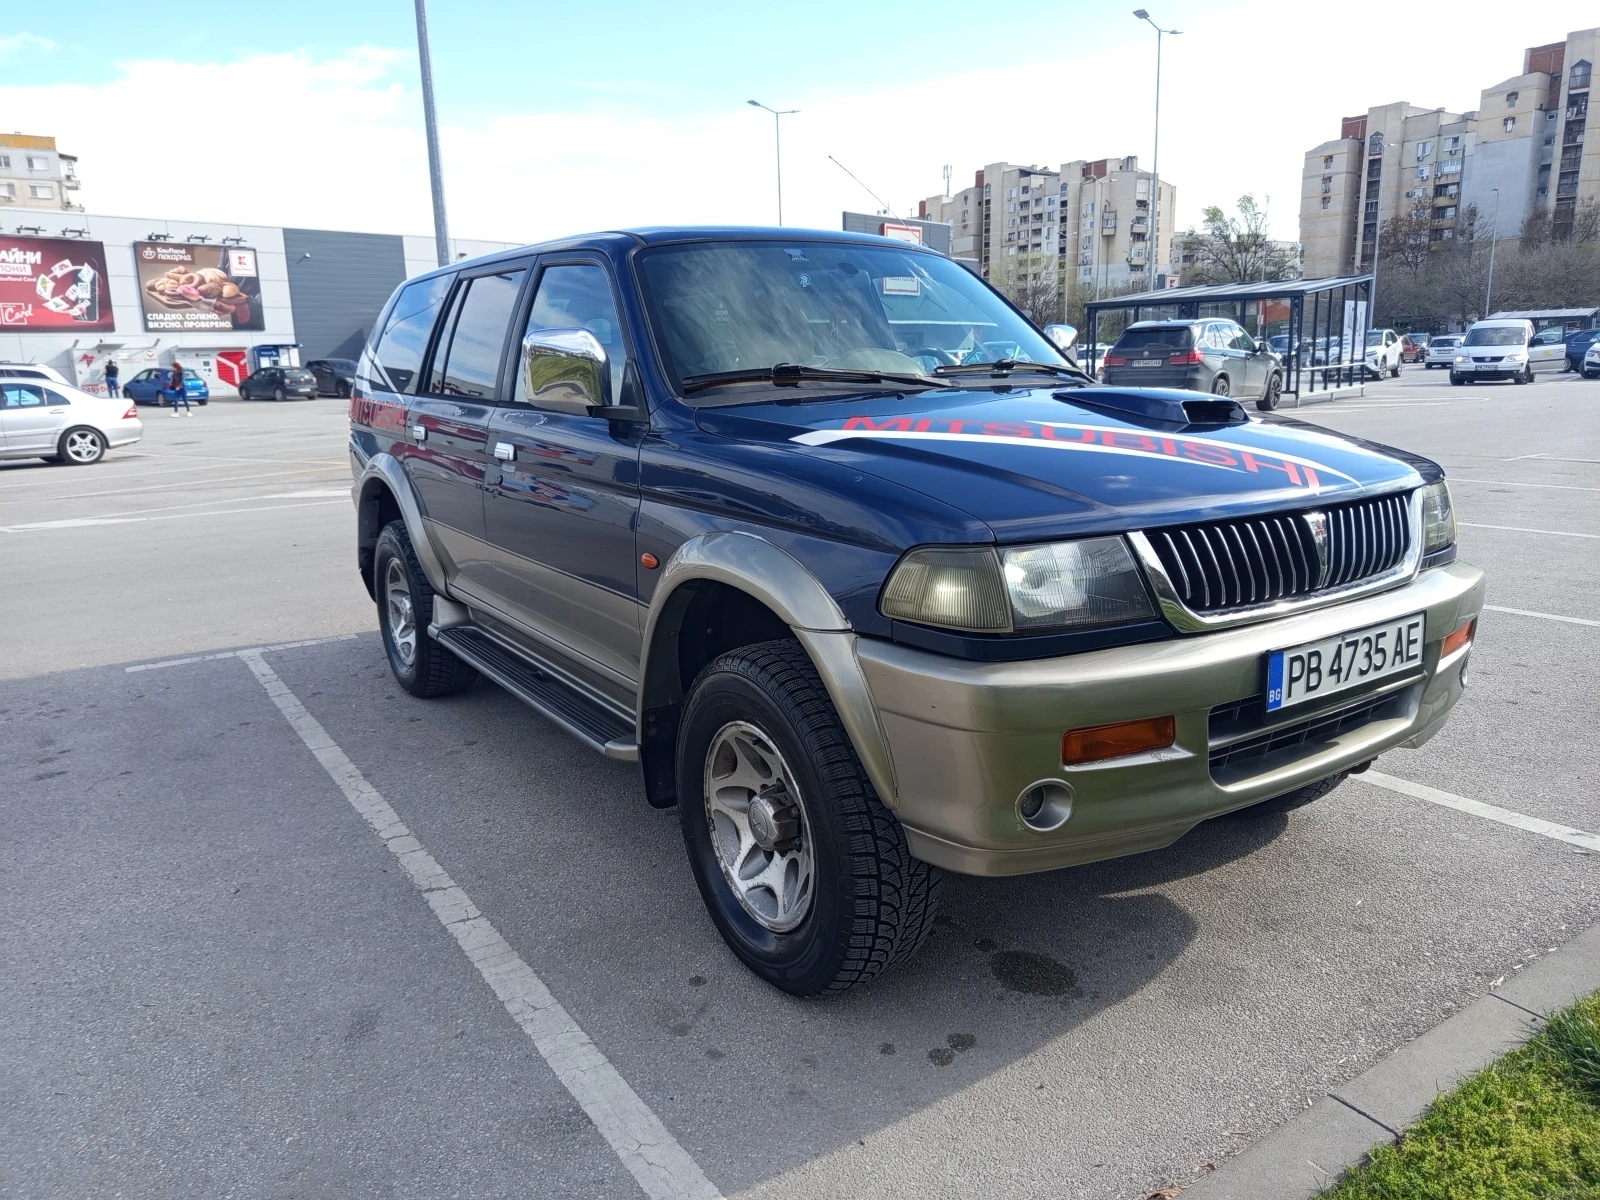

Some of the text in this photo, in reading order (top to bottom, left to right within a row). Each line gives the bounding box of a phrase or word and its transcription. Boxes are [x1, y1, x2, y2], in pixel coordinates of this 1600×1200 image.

[5, 303, 34, 322] Card
[148, 321, 233, 329] ВКУСНО. ПРОВЕРЕНО.
[842, 415, 1321, 497] MITSUBISHI
[1287, 621, 1420, 699] PB 4735 AE
[1268, 687, 1282, 703] BG
